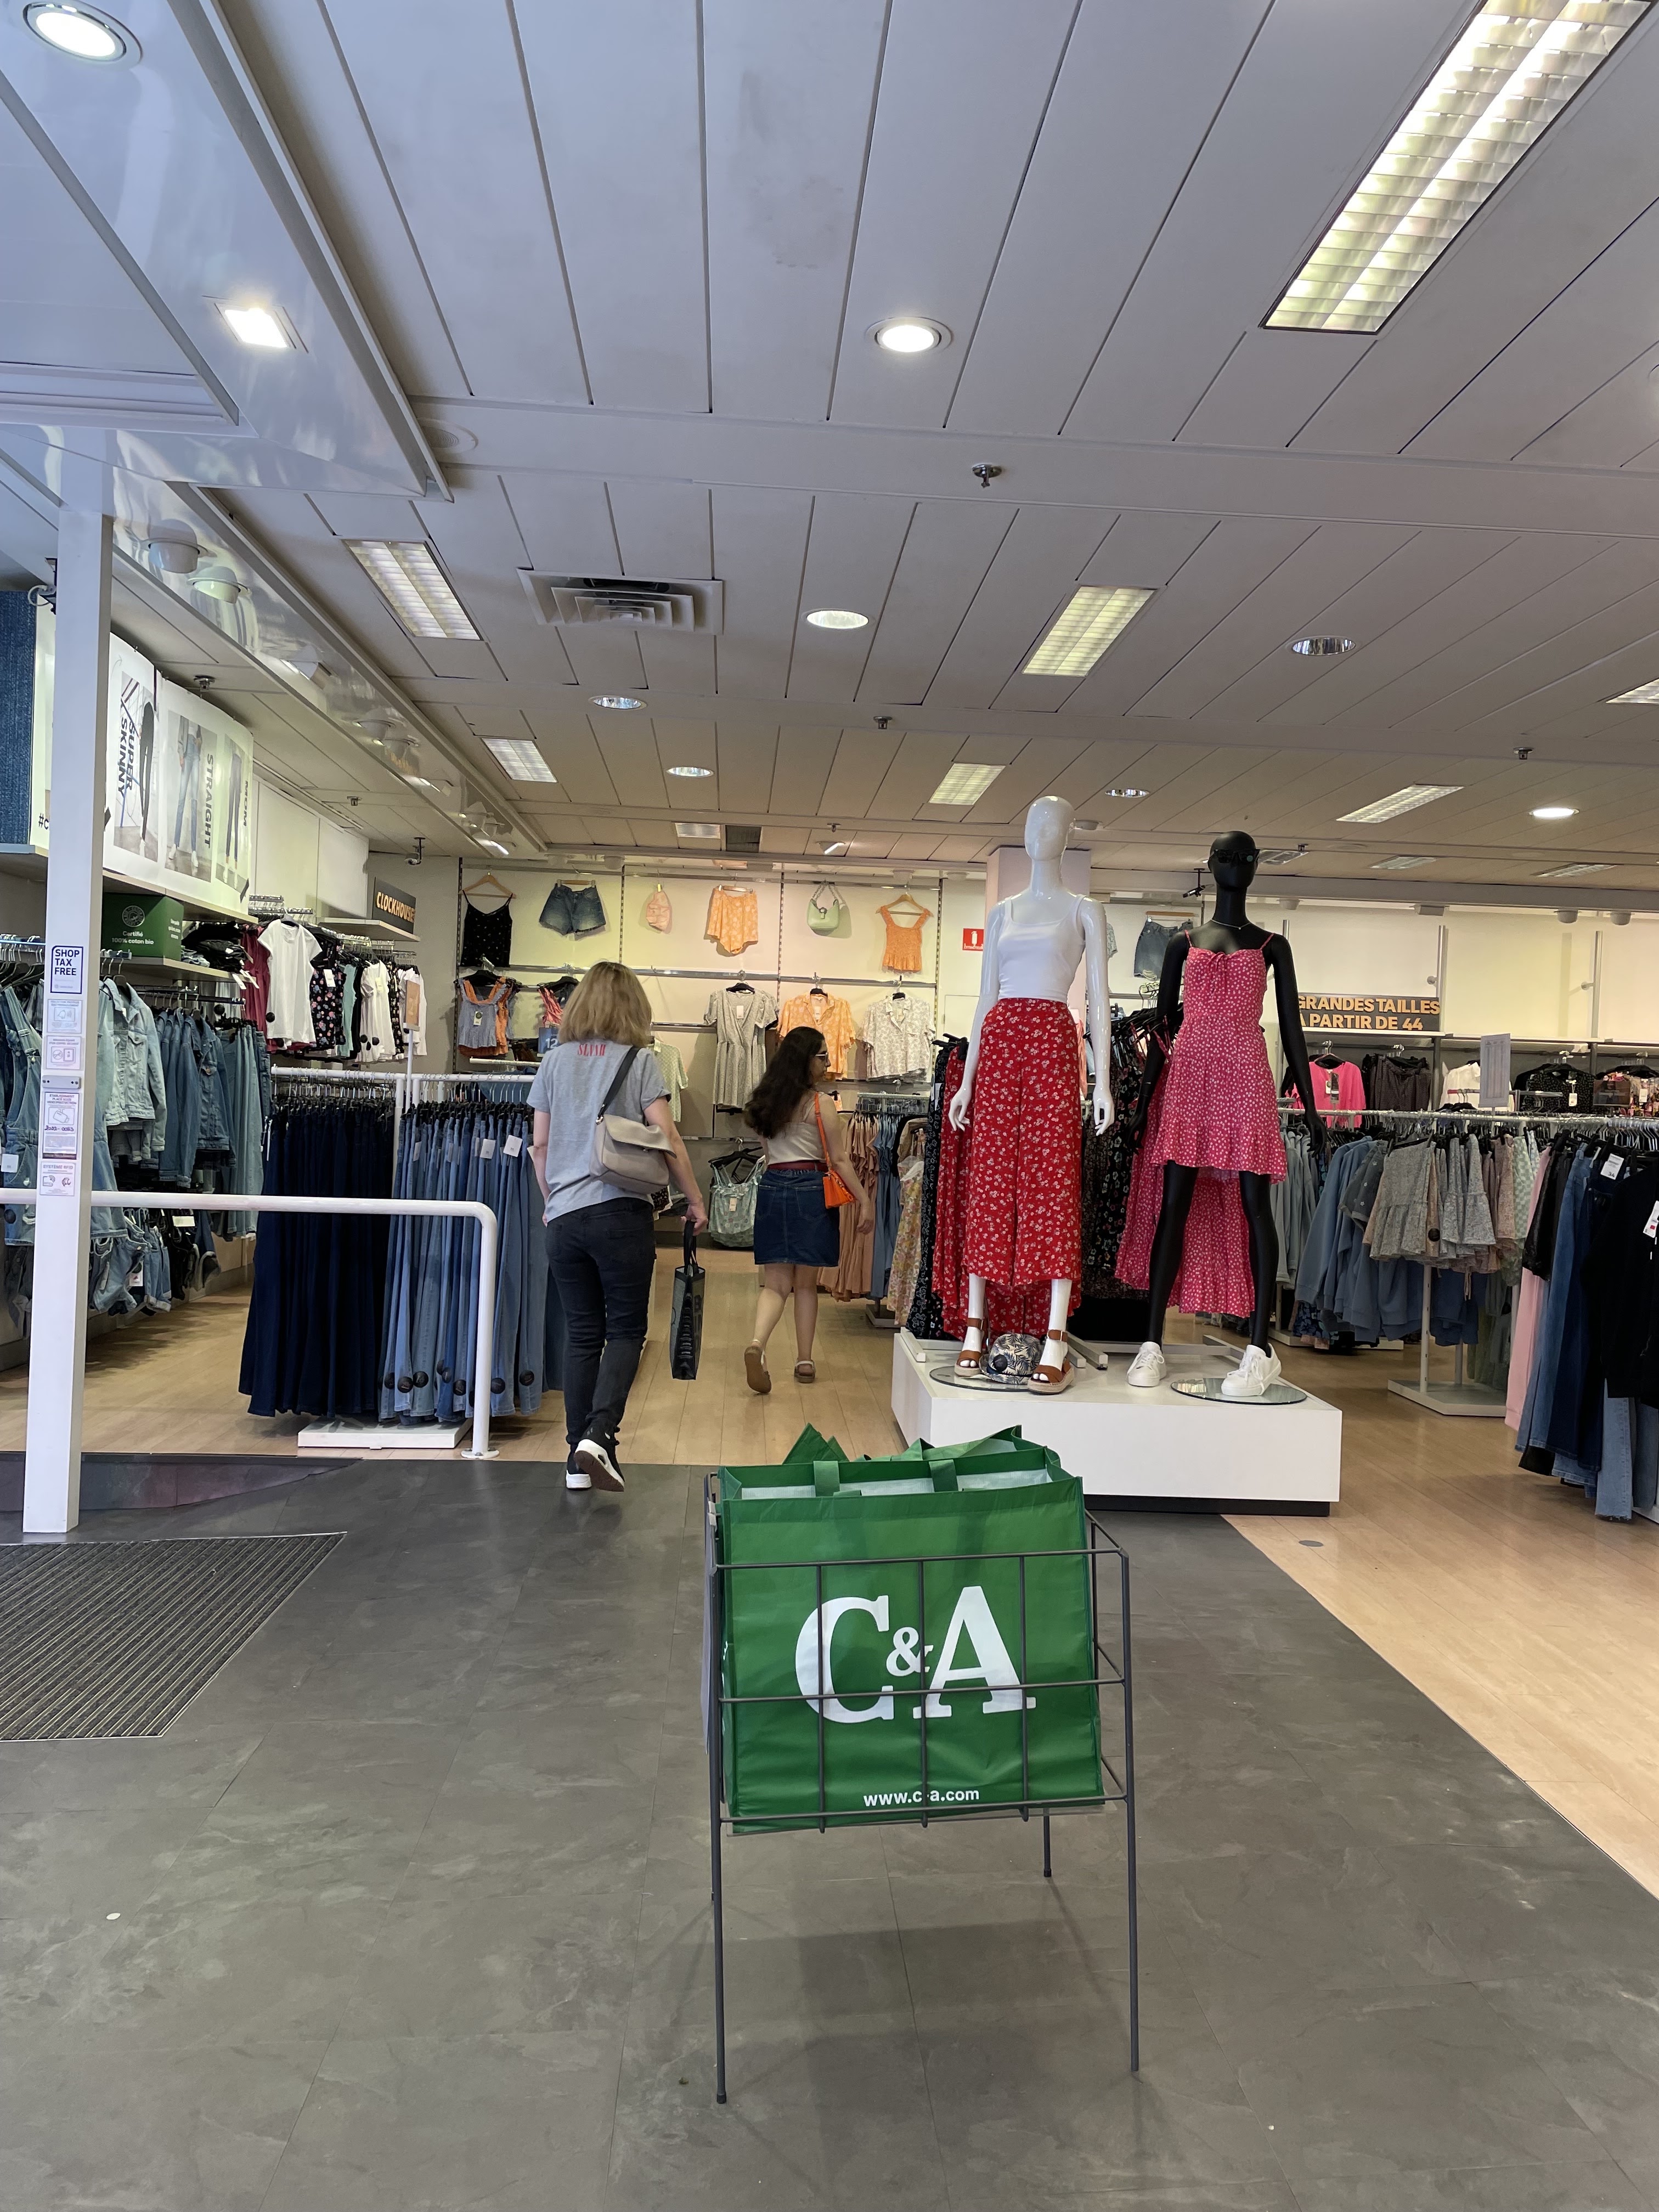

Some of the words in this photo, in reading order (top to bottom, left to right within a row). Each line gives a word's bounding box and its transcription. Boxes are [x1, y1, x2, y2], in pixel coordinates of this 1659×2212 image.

[117, 717, 127, 799] SKINNY
[126, 721, 136, 791] SUPER
[204, 753, 214, 849] STRAIGHT
[376, 891, 416, 923] CLOCKHOUSE
[55, 949, 80, 957] SHOP
[55, 958, 72, 967] TAX
[54, 967, 77, 975] FREE
[1298, 995, 1375, 1012] GRANDES
[1375, 998, 1440, 1015] TAILLES
[1310, 1013, 1373, 1029] PARTIR
[1375, 1015, 1398, 1030] DE
[1402, 1017, 1423, 1031] 44
[795, 1585, 1036, 1724] C&A
